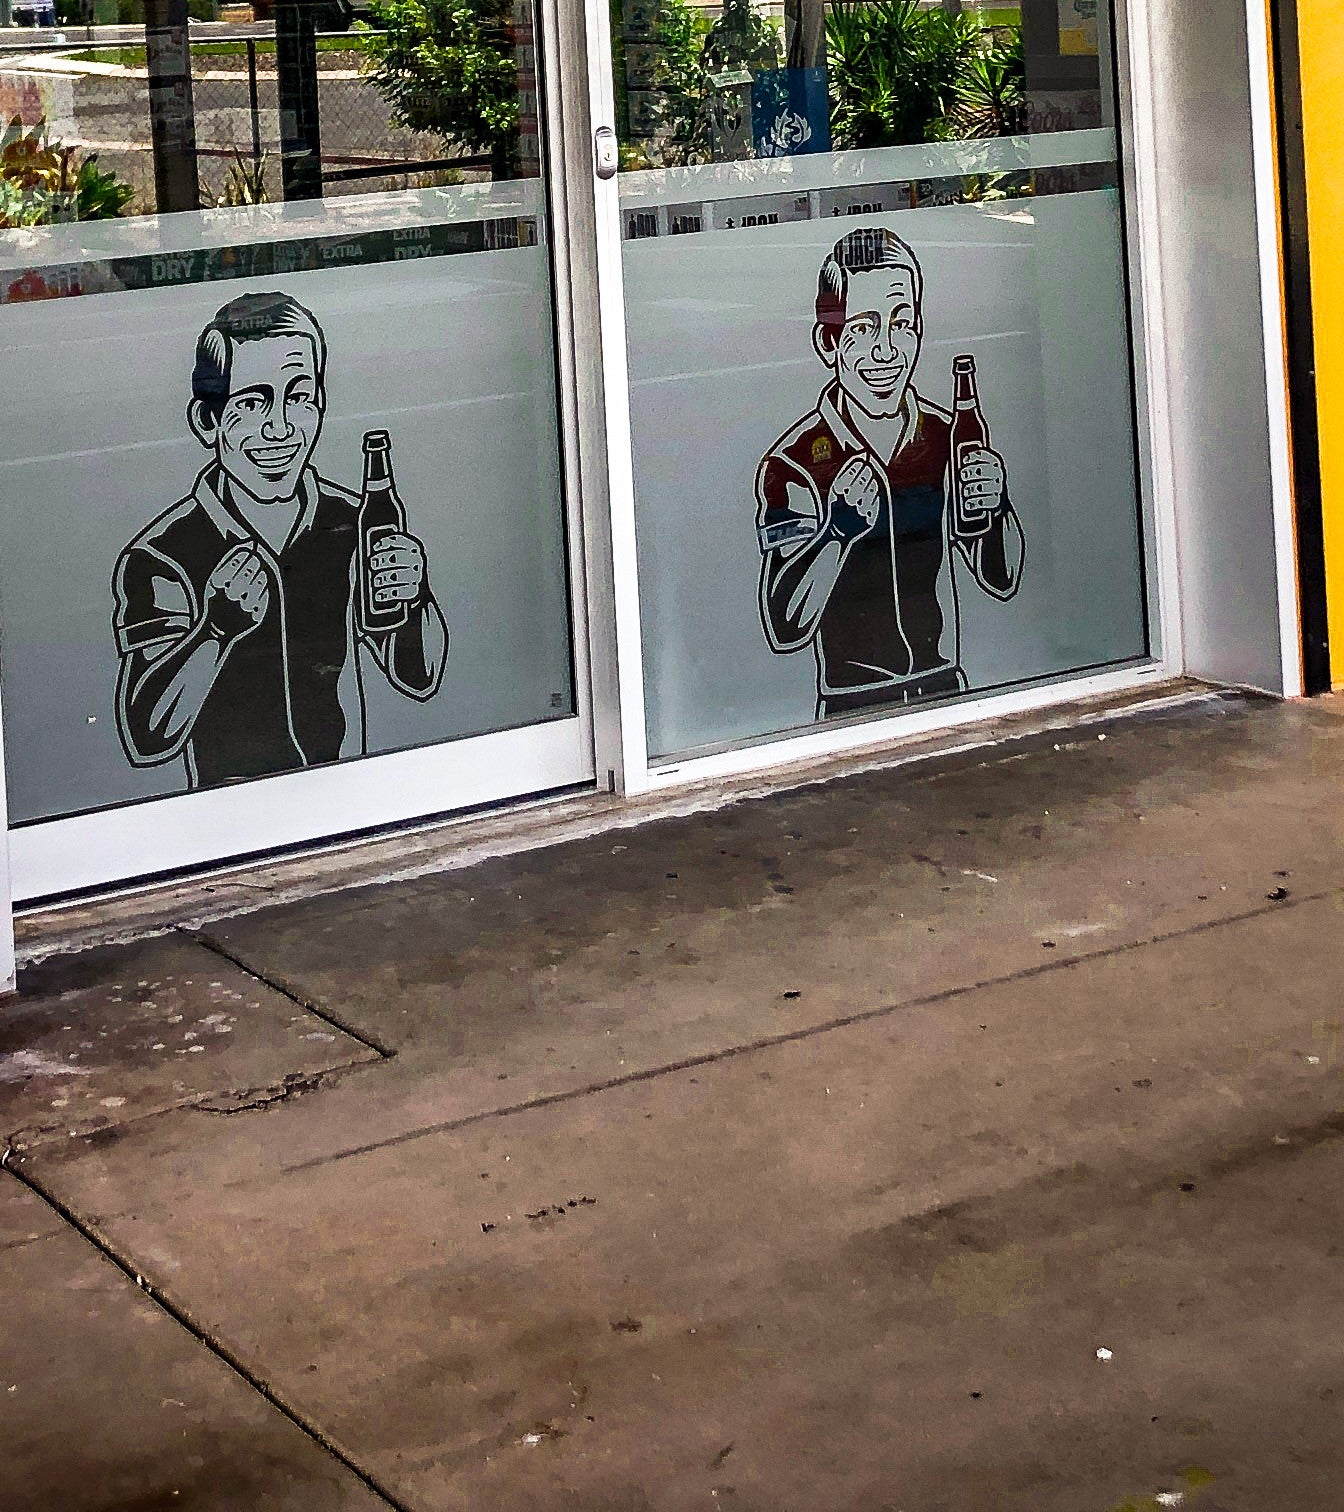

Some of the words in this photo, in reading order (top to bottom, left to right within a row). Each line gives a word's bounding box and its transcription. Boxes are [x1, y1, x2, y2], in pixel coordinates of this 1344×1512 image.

[322, 244, 364, 259] EXTRA
[151, 254, 195, 281] DRY
[232, 316, 273, 331] EXTRA
